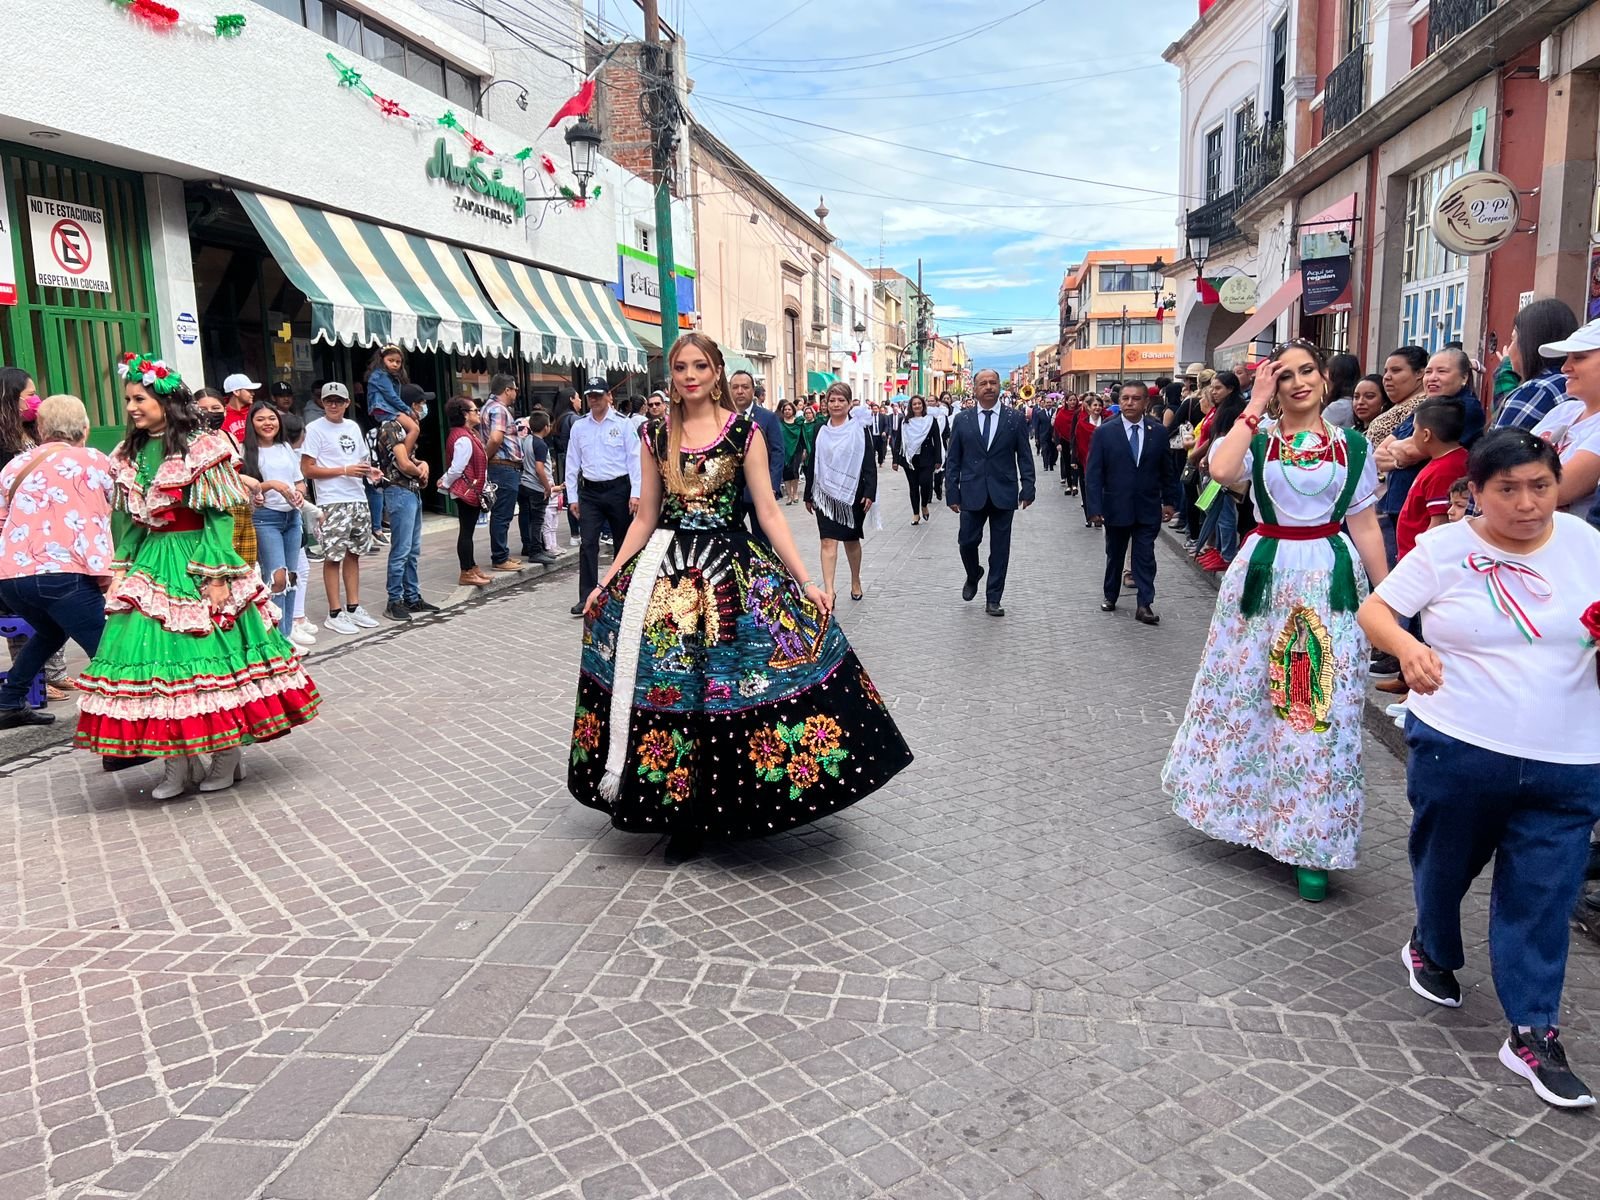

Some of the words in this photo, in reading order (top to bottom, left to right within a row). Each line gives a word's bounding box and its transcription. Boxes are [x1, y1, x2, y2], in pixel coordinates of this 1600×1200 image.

[30, 199, 43, 213] NO
[45, 202, 54, 215] TE
[56, 205, 102, 224] ESTACIONES
[455, 196, 513, 224] ZAPATERIAS
[38, 273, 69, 287] RESPETA
[70, 276, 79, 288] MI
[80, 279, 110, 291] COCHERA
[1307, 273, 1336, 281] regalan
[1141, 351, 1175, 359] Baname
